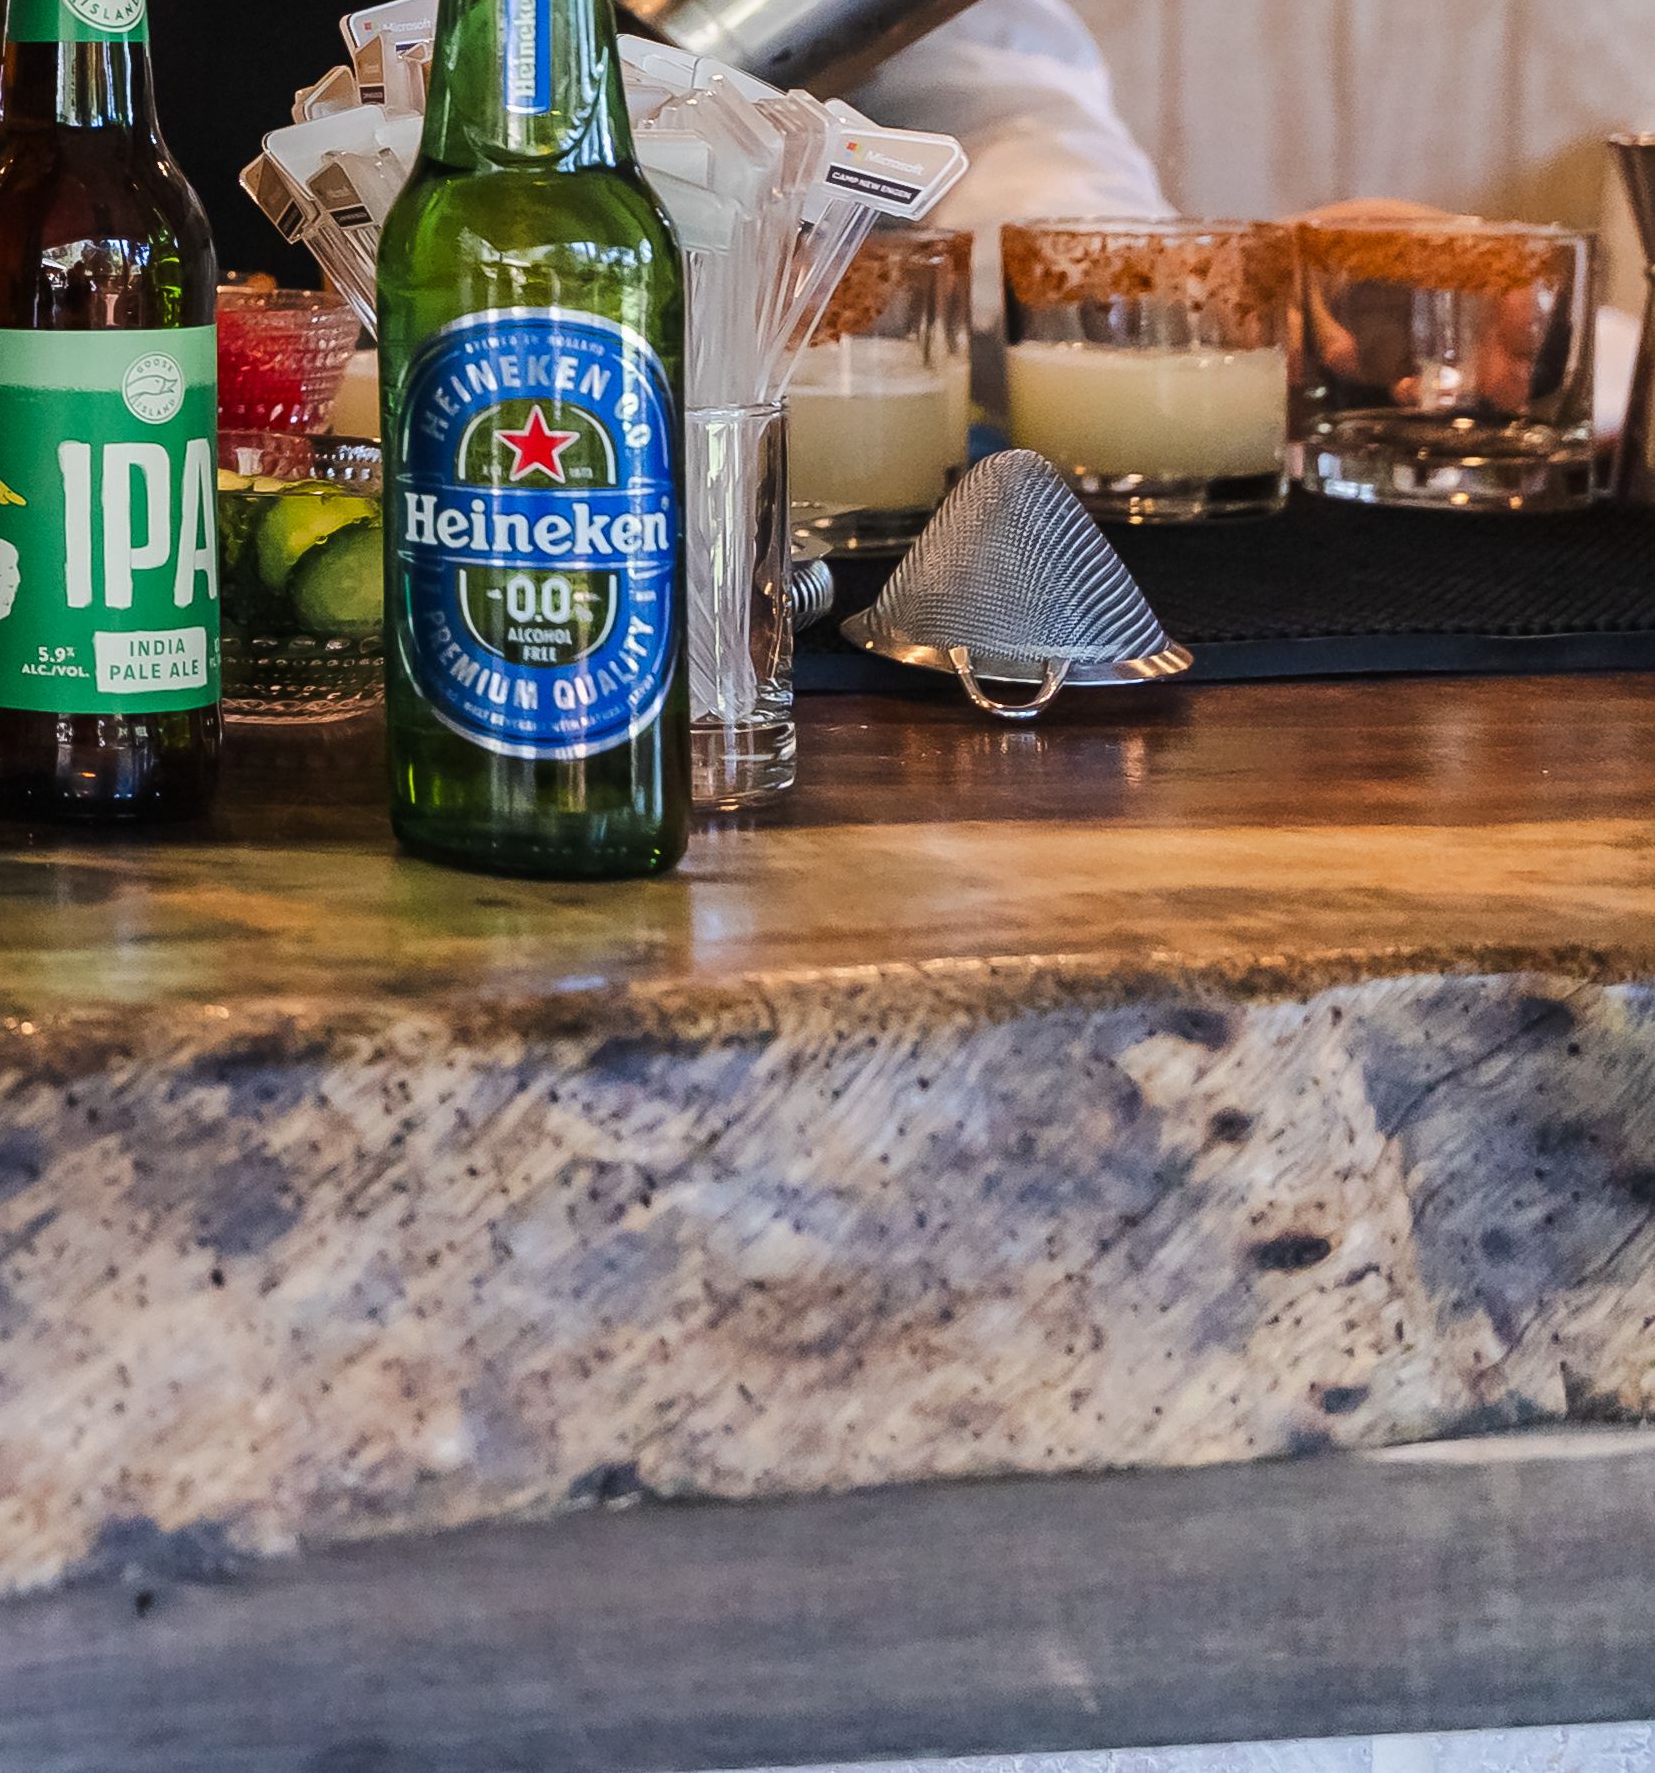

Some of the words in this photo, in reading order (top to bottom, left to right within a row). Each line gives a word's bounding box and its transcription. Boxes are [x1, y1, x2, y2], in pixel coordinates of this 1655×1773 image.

[831, 171, 860, 184] CAMP
[137, 358, 174, 374] GOOSE
[133, 397, 176, 418] ISLAND
[423, 354, 611, 441] HEINEKEN
[57, 438, 218, 610] IPA
[404, 492, 670, 557] Heineken
[508, 627, 573, 645] ALCOHOL
[129, 639, 186, 658] INDIA
[522, 646, 557, 663] FREE
[21, 664, 90, 678] ALC./VOL.
[110, 663, 162, 681] PALE
[168, 659, 199, 677] ALE
[553, 615, 655, 711] QUALITY
